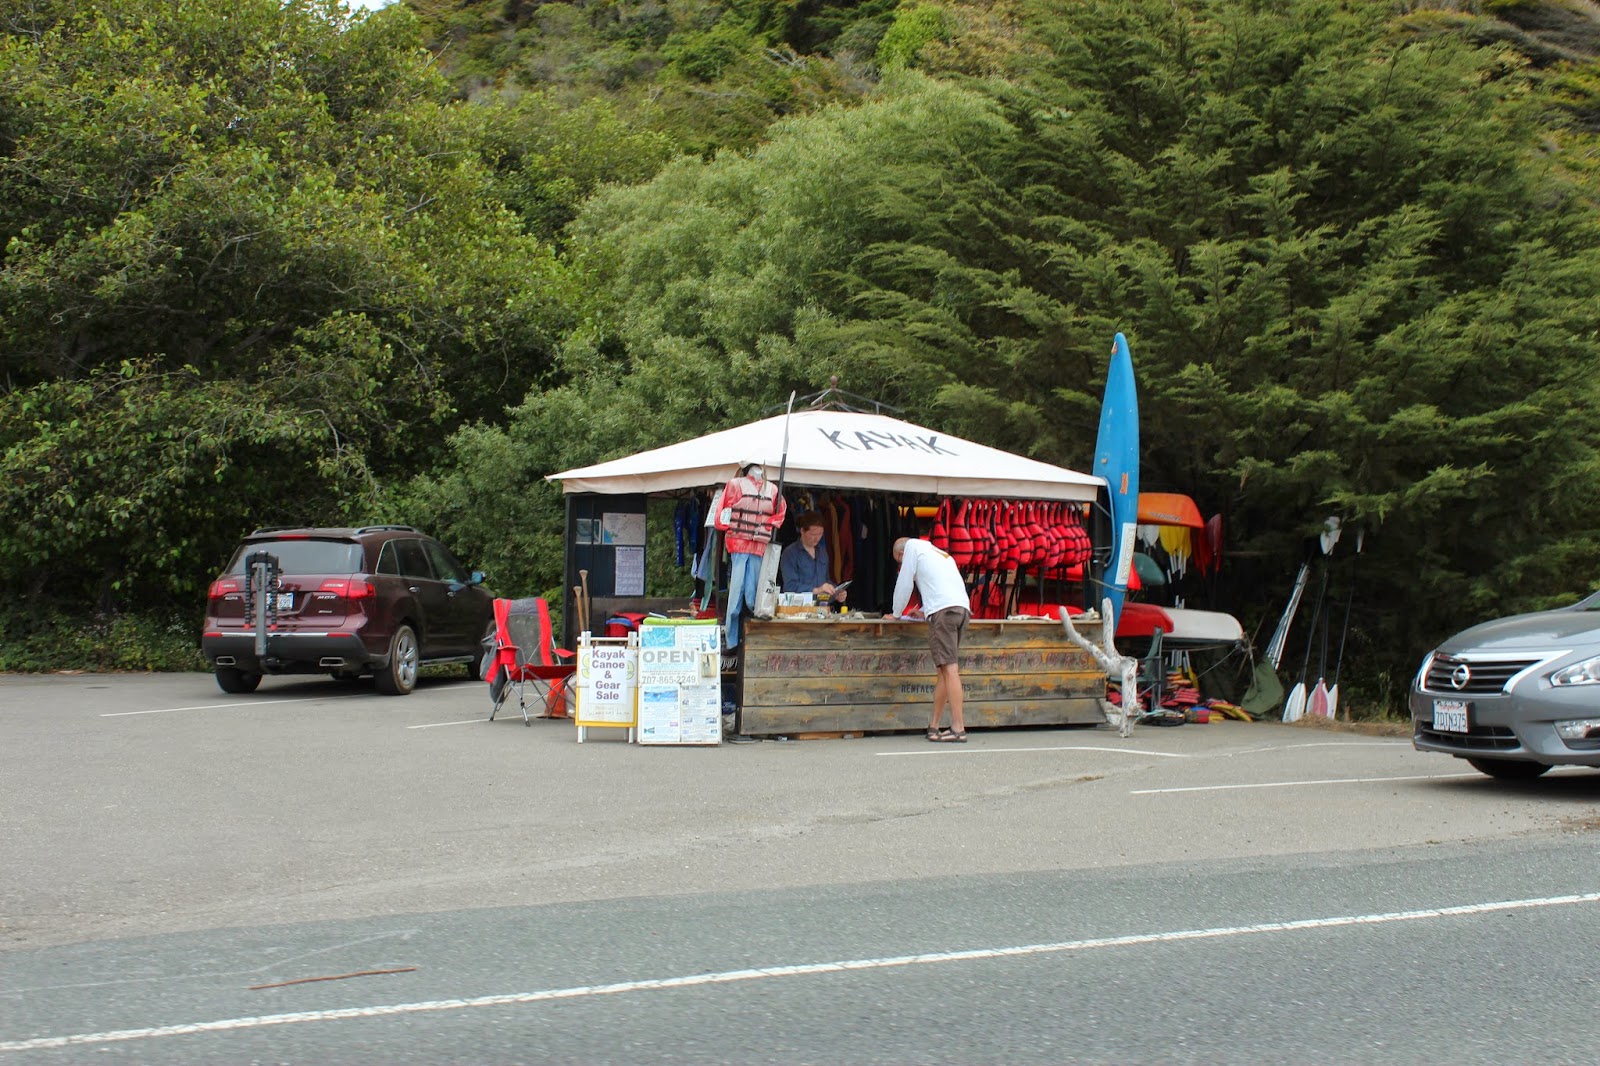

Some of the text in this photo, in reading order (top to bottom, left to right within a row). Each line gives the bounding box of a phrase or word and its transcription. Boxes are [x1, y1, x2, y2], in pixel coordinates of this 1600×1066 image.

[816, 427, 959, 456] KAYAK
[592, 650, 625, 660] Kayak
[642, 650, 695, 663] OPEN
[592, 661, 625, 669] Canoe
[604, 671, 612, 679] &
[641, 675, 696, 684] 707-865-2249
[595, 681, 621, 689] Gear
[901, 684, 935, 693] RENTALS
[596, 691, 620, 700] Sale
